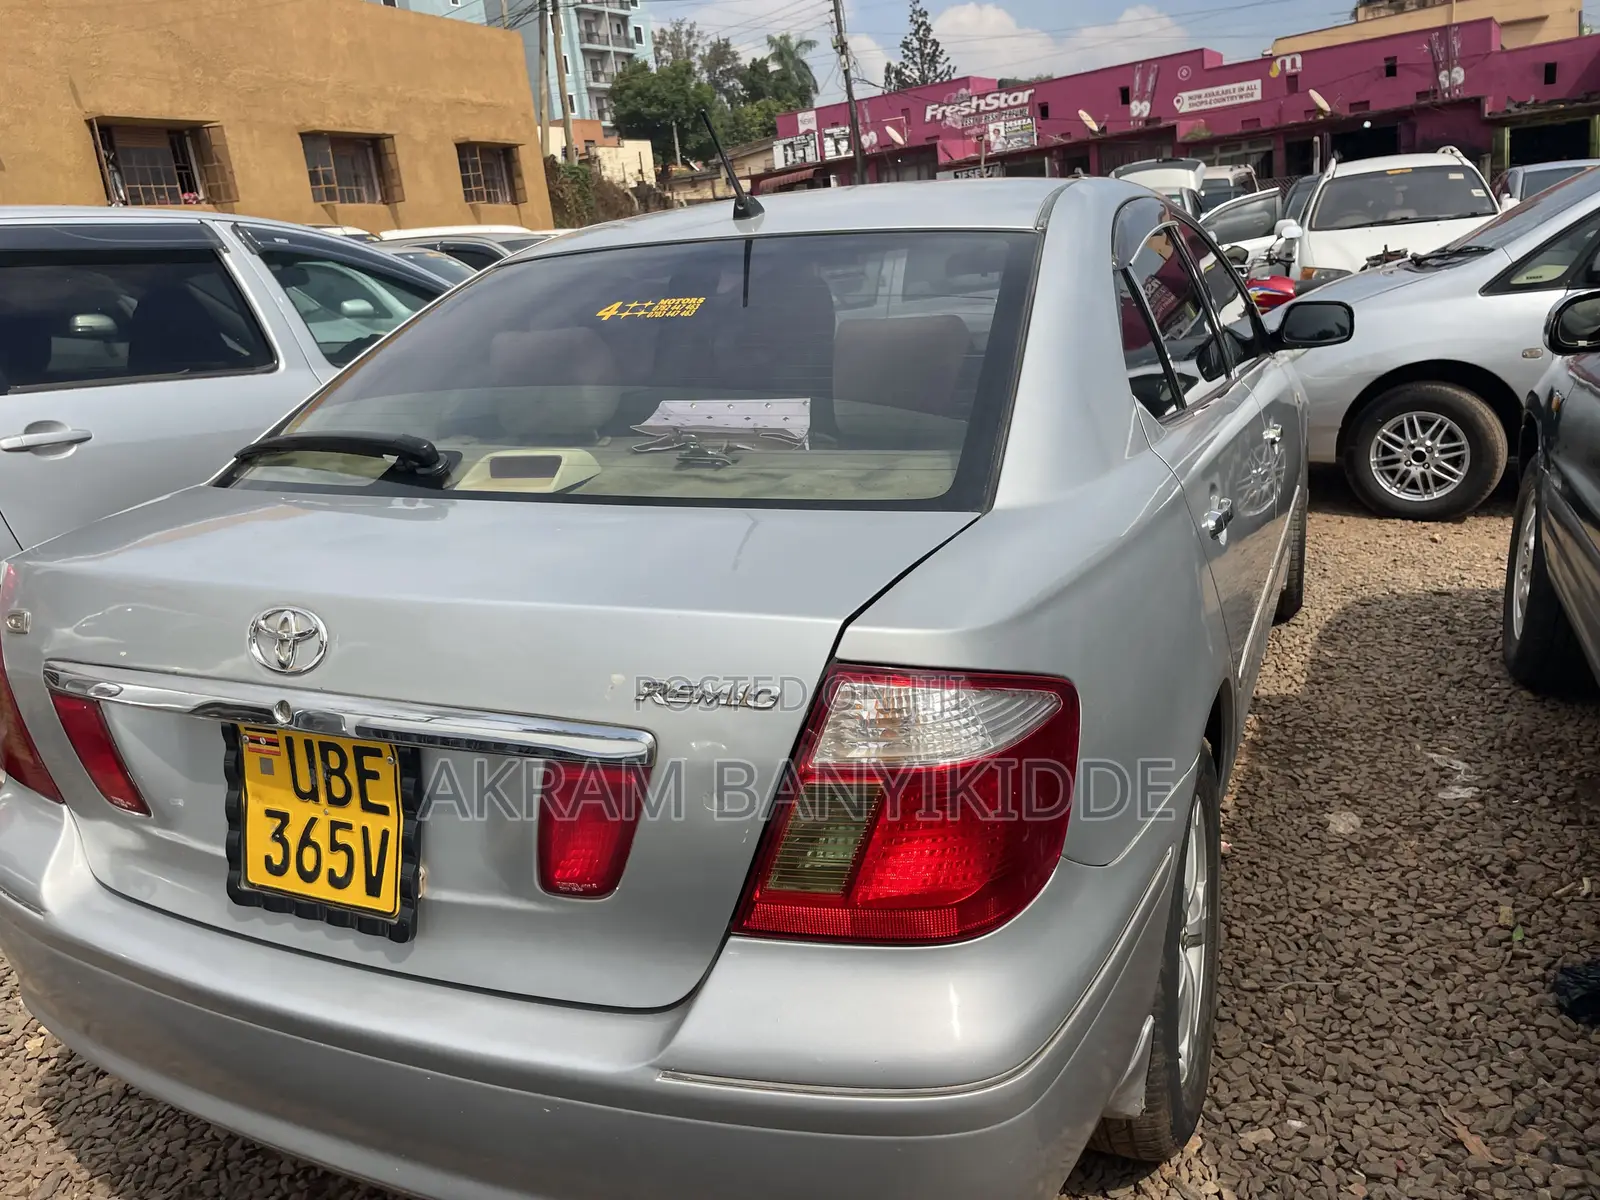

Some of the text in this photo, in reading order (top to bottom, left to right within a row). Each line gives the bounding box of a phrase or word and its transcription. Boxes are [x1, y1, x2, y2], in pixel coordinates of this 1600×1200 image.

[924, 88, 1035, 122] FreshStar
[1204, 87, 1236, 99] AVAILABLE
[1246, 84, 1258, 92] ALL
[658, 297, 706, 305] MOTORS
[285, 735, 390, 816] UBE
[264, 808, 391, 899] 365V
